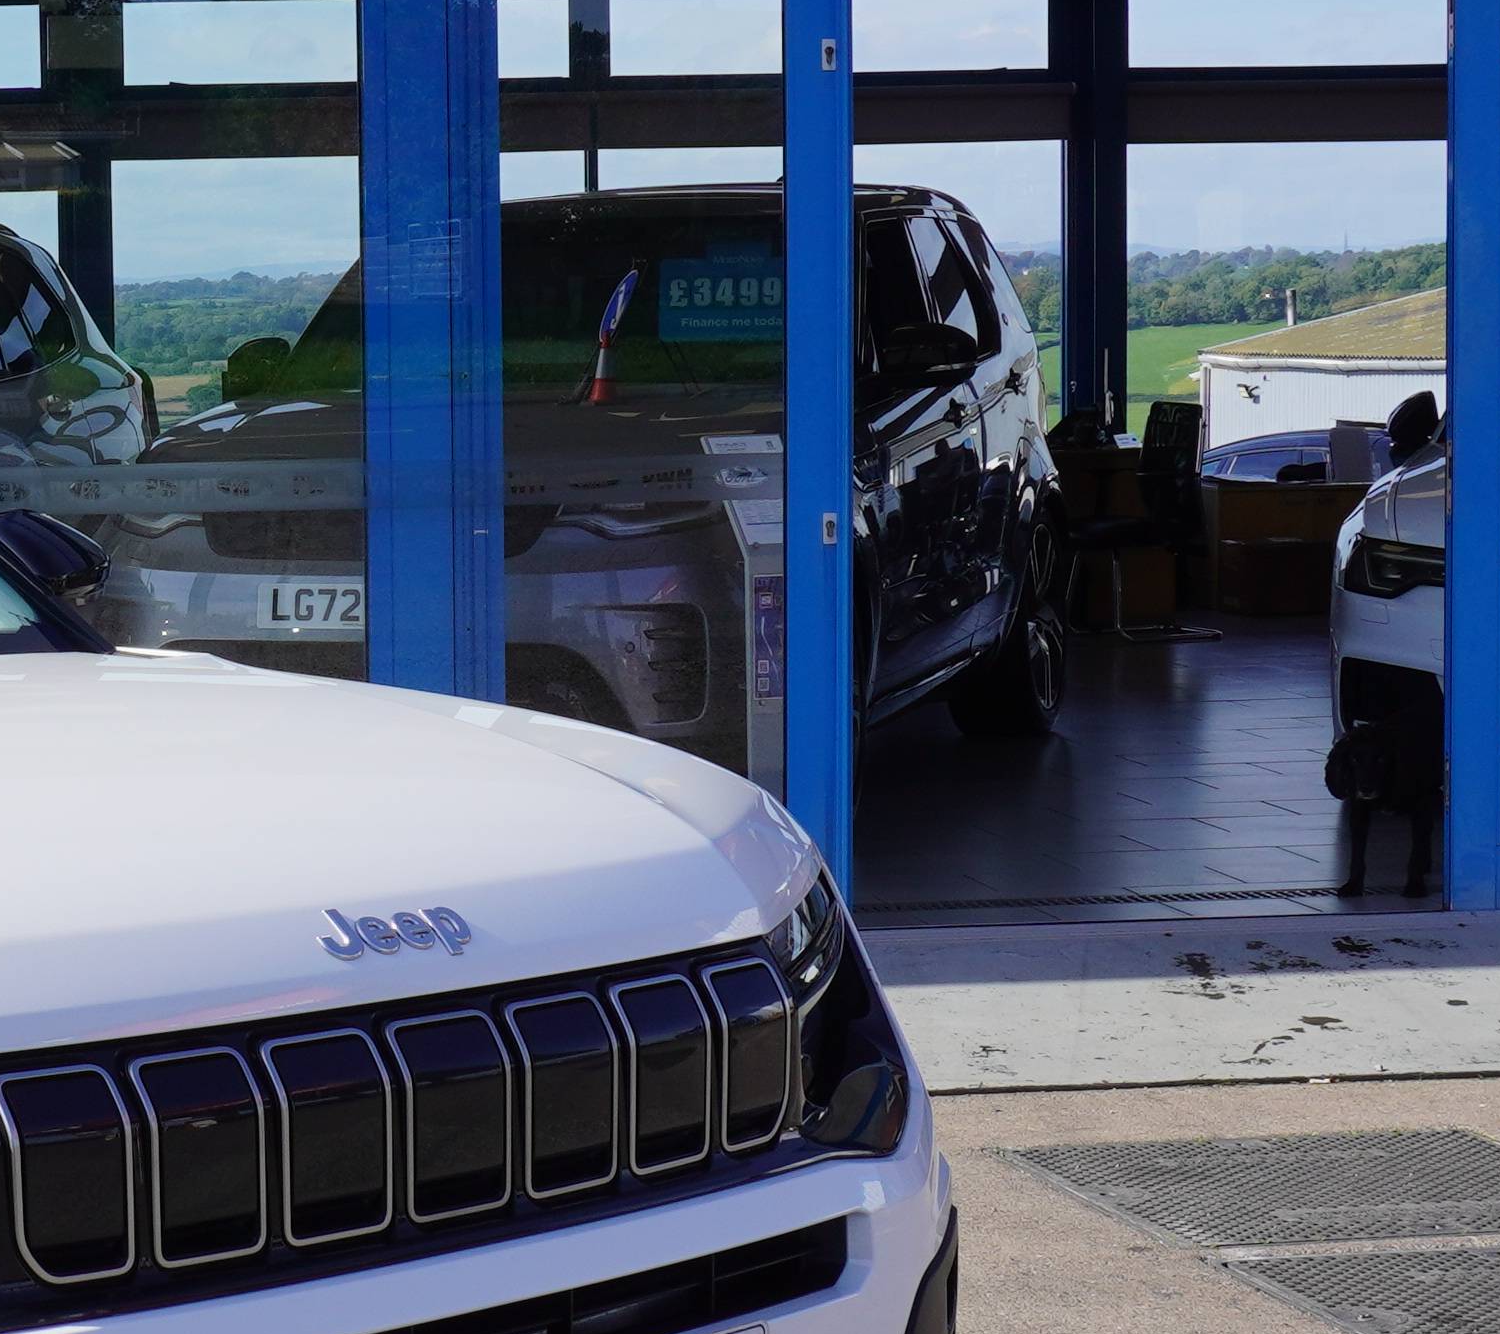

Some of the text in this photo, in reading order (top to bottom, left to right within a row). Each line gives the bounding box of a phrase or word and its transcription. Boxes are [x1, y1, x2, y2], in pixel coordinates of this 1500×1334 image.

[669, 277, 782, 307] £3499
[680, 315, 783, 329] Finance me toda
[271, 587, 362, 621] LG72
[316, 906, 473, 962] Jeep
